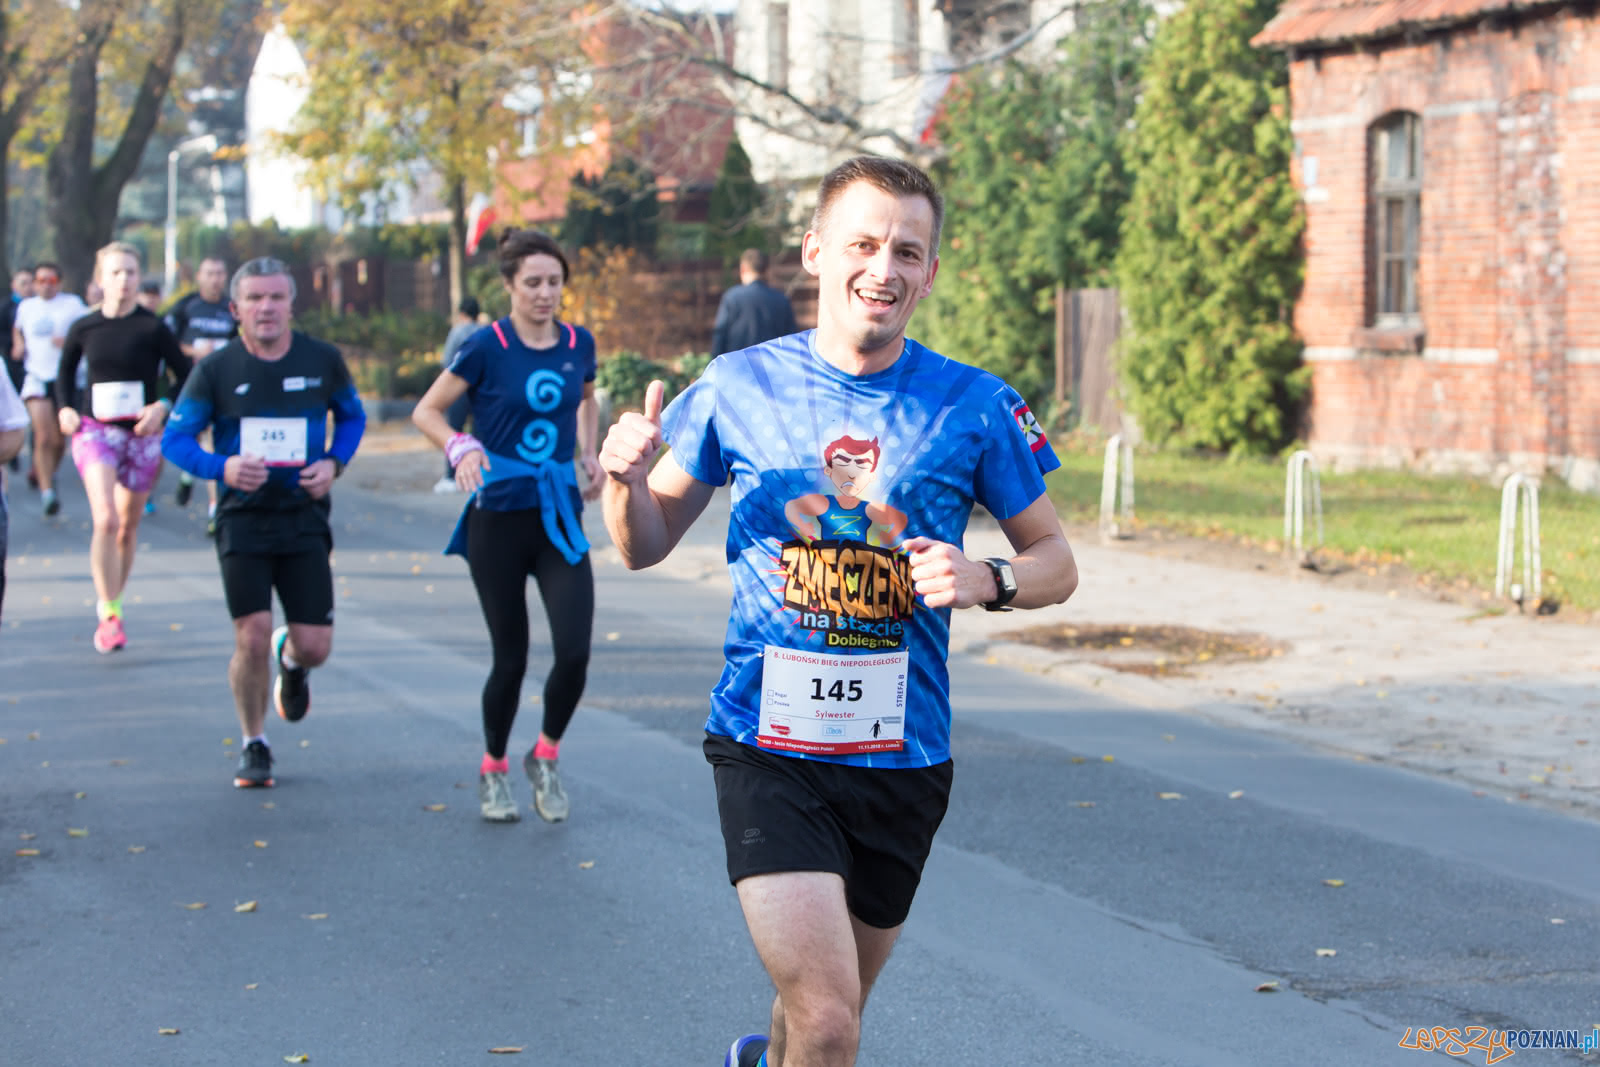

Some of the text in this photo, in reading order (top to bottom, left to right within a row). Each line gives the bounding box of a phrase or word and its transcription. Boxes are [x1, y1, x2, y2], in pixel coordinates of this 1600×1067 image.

[261, 429, 286, 441] 245
[803, 612, 830, 628] na
[821, 659, 839, 667] BIEG
[840, 656, 902, 667] NIEPODLEGŁOŚCI
[810, 678, 863, 702] 145
[896, 681, 905, 708] STREFA
[815, 710, 855, 719] Sylwester
